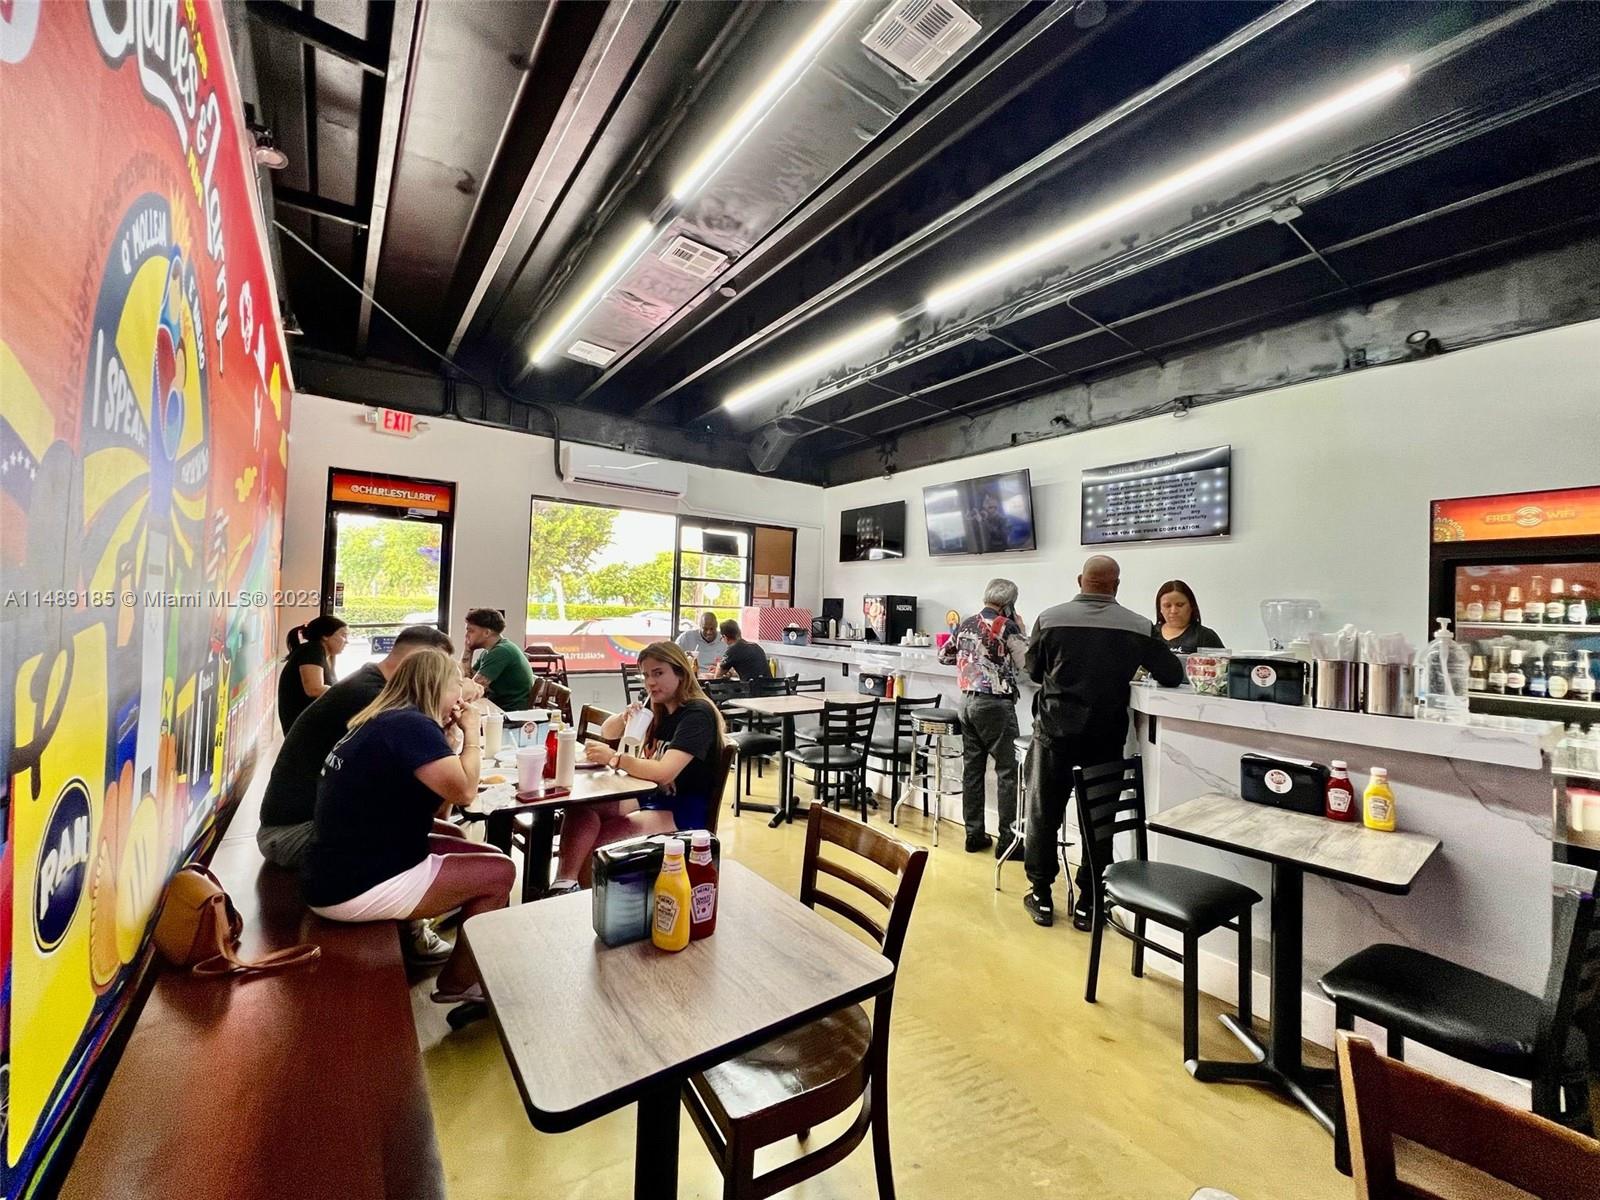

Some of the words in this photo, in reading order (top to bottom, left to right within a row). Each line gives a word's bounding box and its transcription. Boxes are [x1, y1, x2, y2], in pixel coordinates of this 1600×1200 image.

[92, 328, 104, 429] I
[104, 356, 148, 448] SPEAK
[383, 410, 414, 433] EXIT
[350, 484, 437, 502] @CHARLESYLARRY
